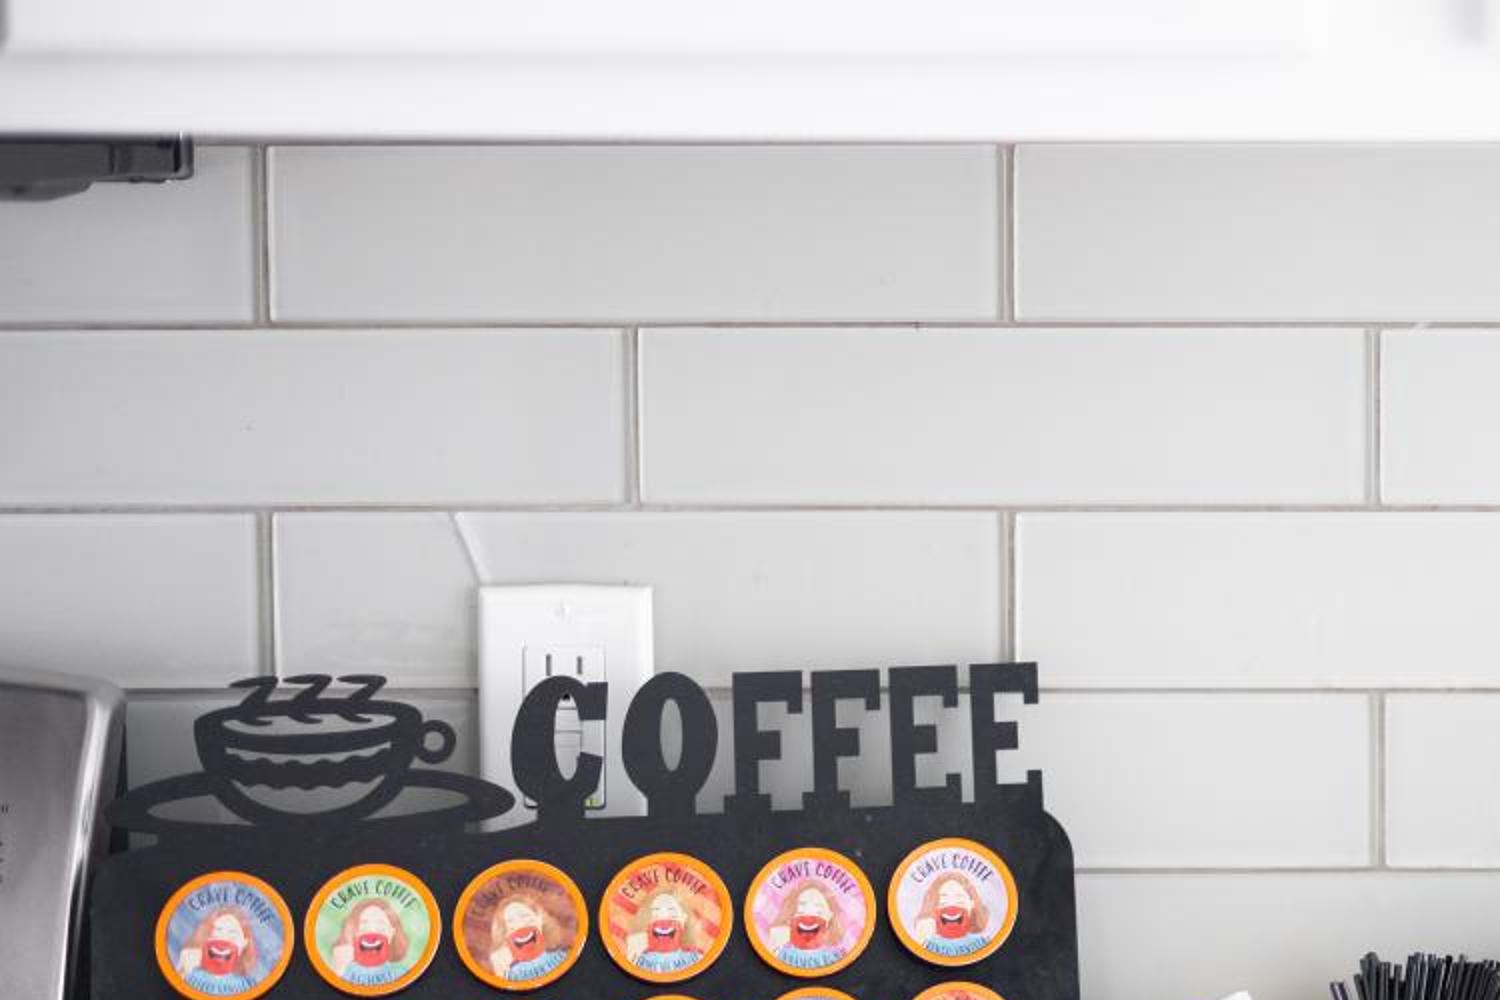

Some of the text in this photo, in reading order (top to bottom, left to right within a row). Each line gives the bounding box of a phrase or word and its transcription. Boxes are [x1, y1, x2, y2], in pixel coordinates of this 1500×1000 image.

[511, 662, 1042, 815] COFFEE
[771, 861, 857, 894] CRAVE COFFEE
[912, 854, 993, 883] CRAVE COFFEE
